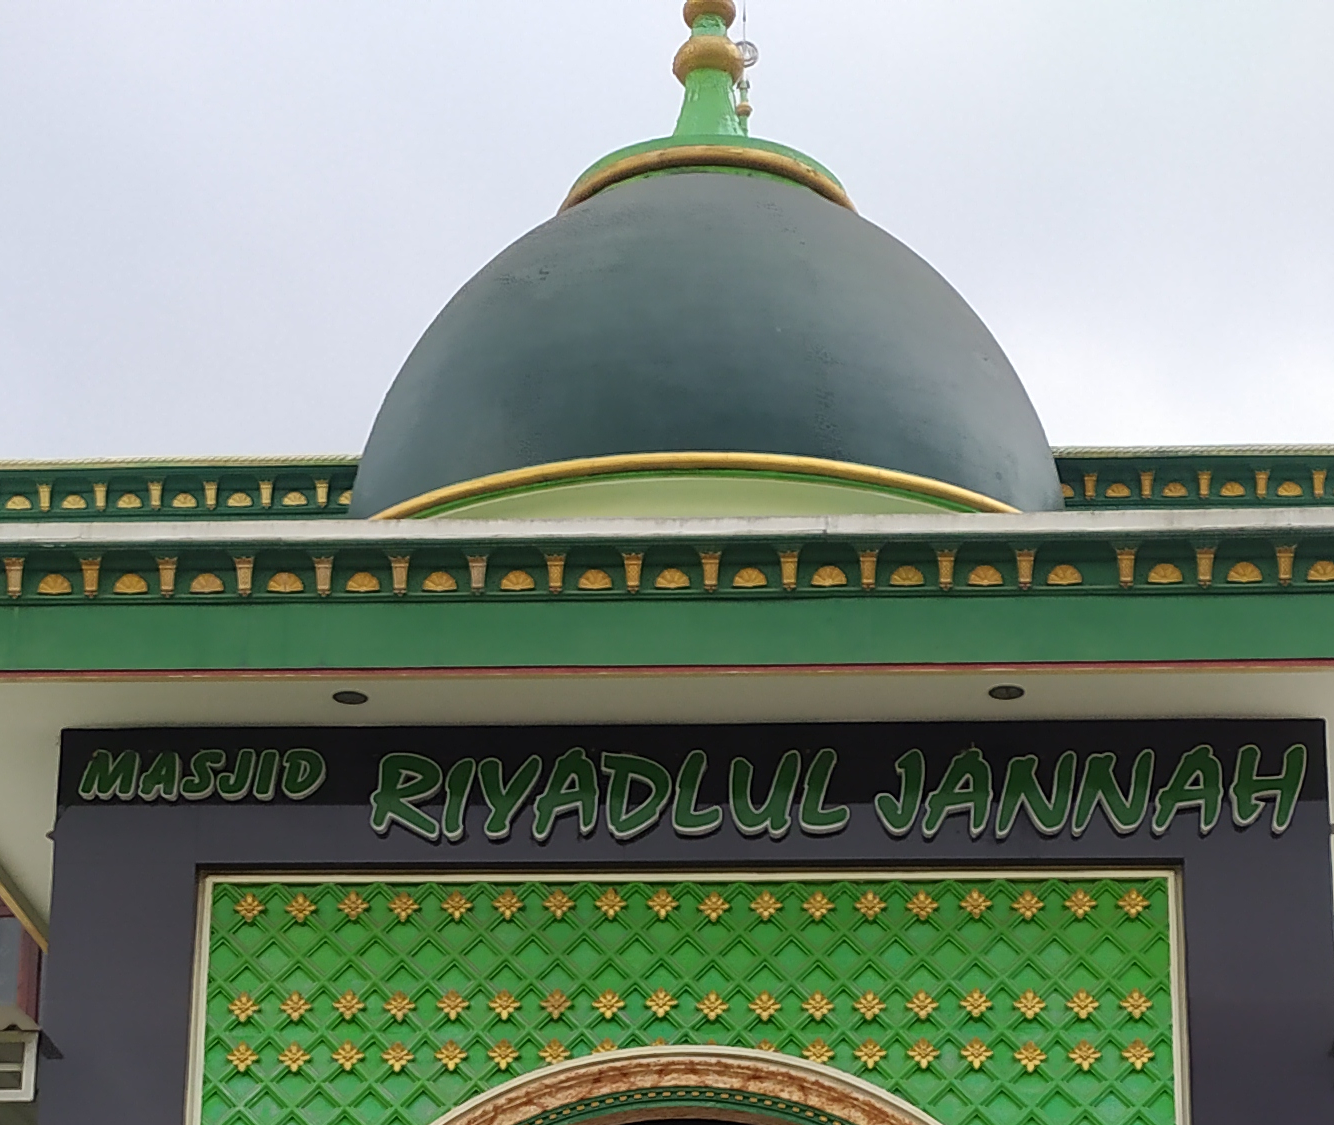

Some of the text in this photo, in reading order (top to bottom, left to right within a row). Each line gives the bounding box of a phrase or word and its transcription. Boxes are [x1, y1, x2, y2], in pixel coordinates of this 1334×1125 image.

[78, 744, 1308, 841] MASJID RIYADLUL JANNAH
